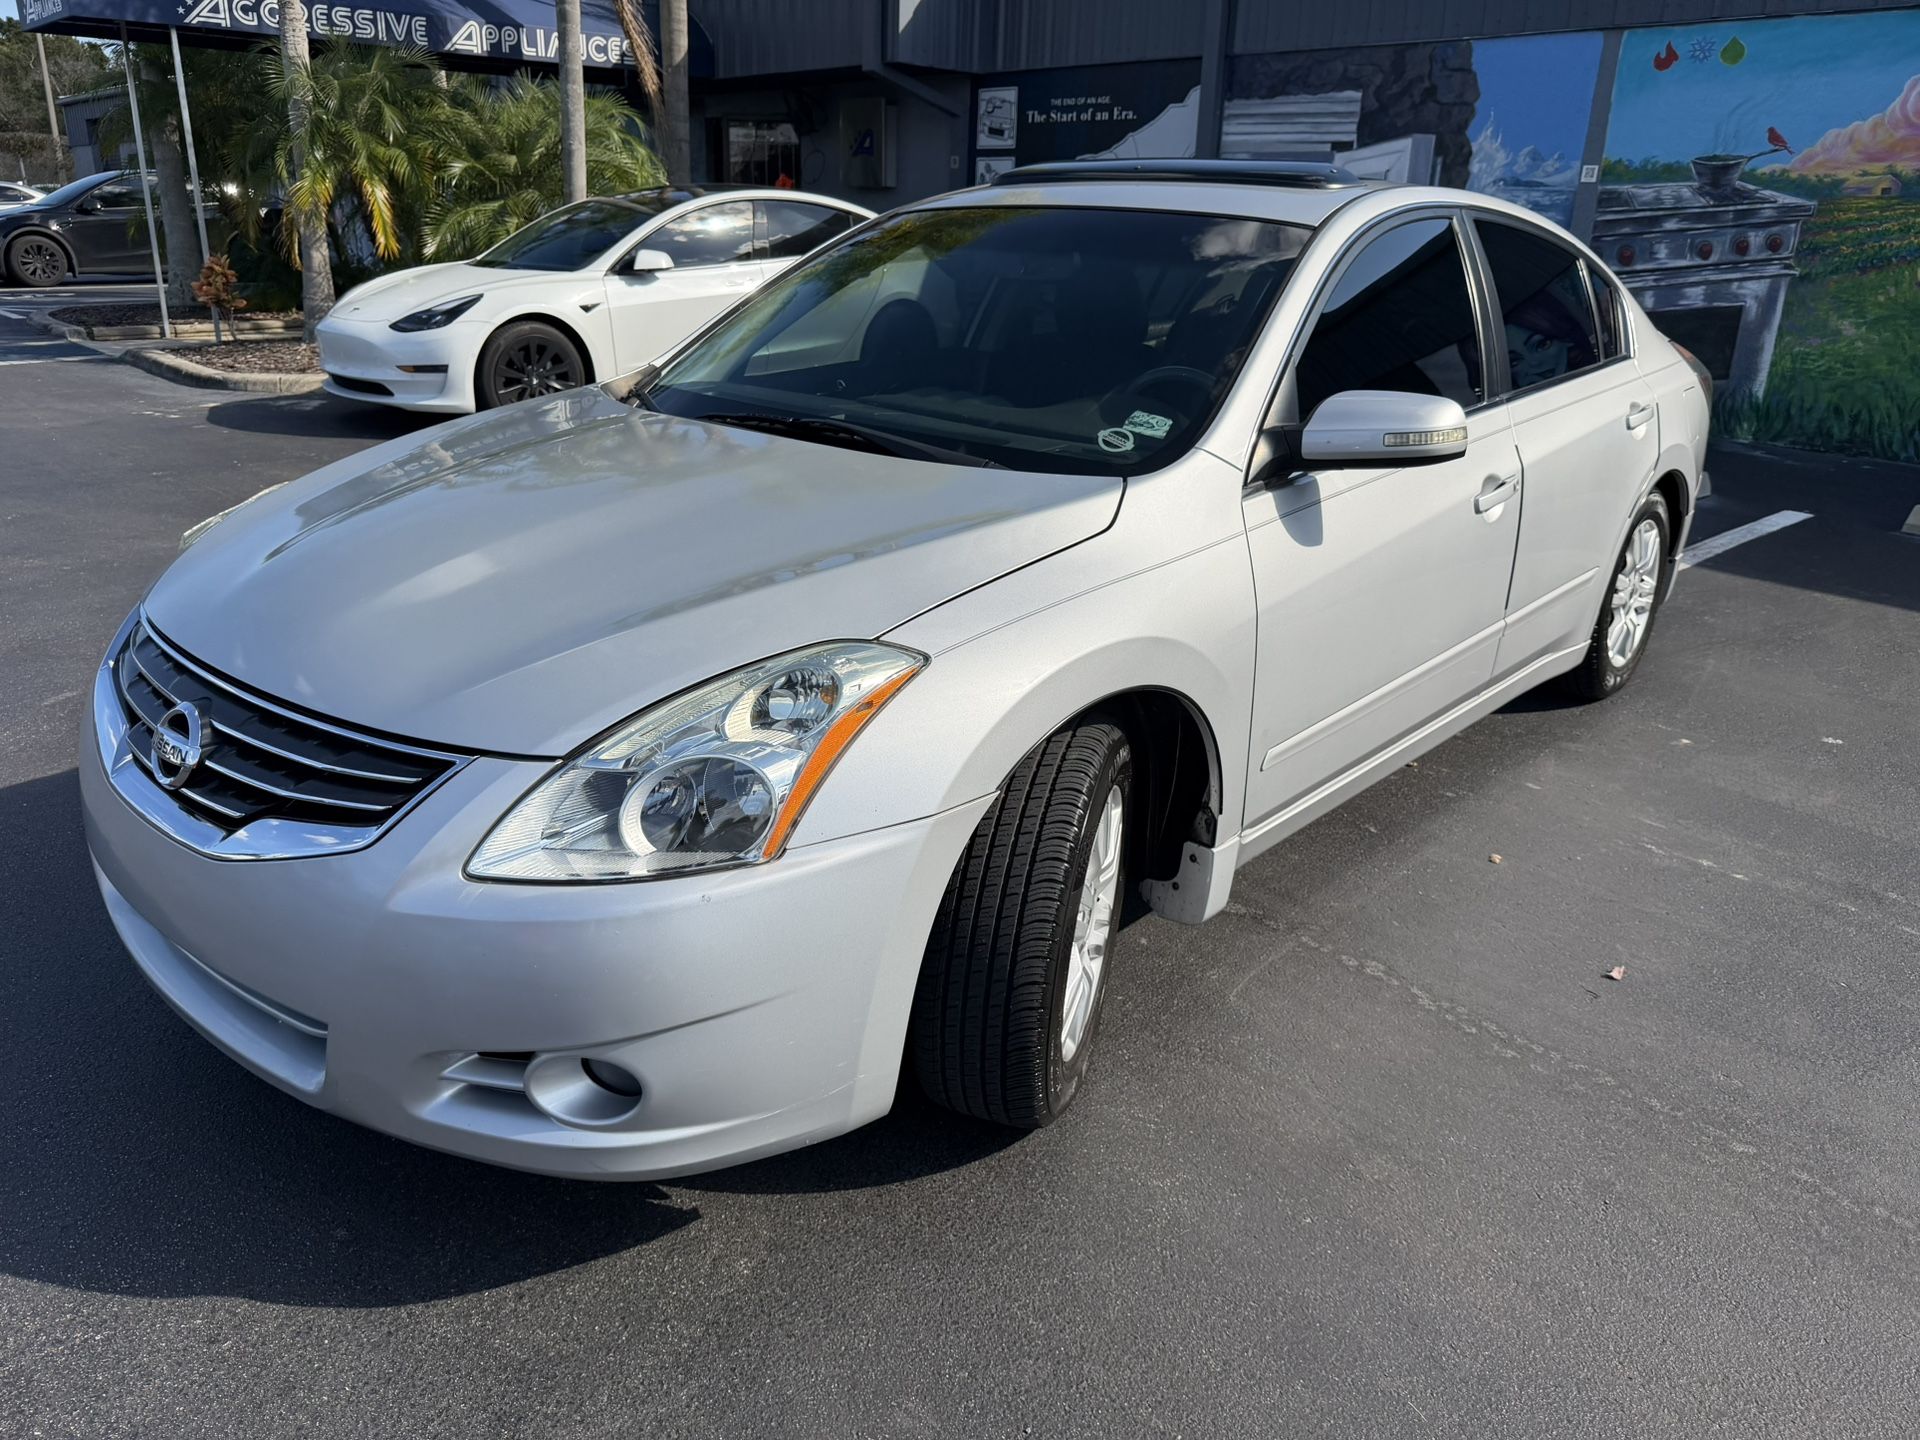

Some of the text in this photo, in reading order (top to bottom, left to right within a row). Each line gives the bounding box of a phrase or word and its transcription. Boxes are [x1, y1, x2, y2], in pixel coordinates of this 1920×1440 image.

[1026, 106, 1137, 123] The Start of an Era.
